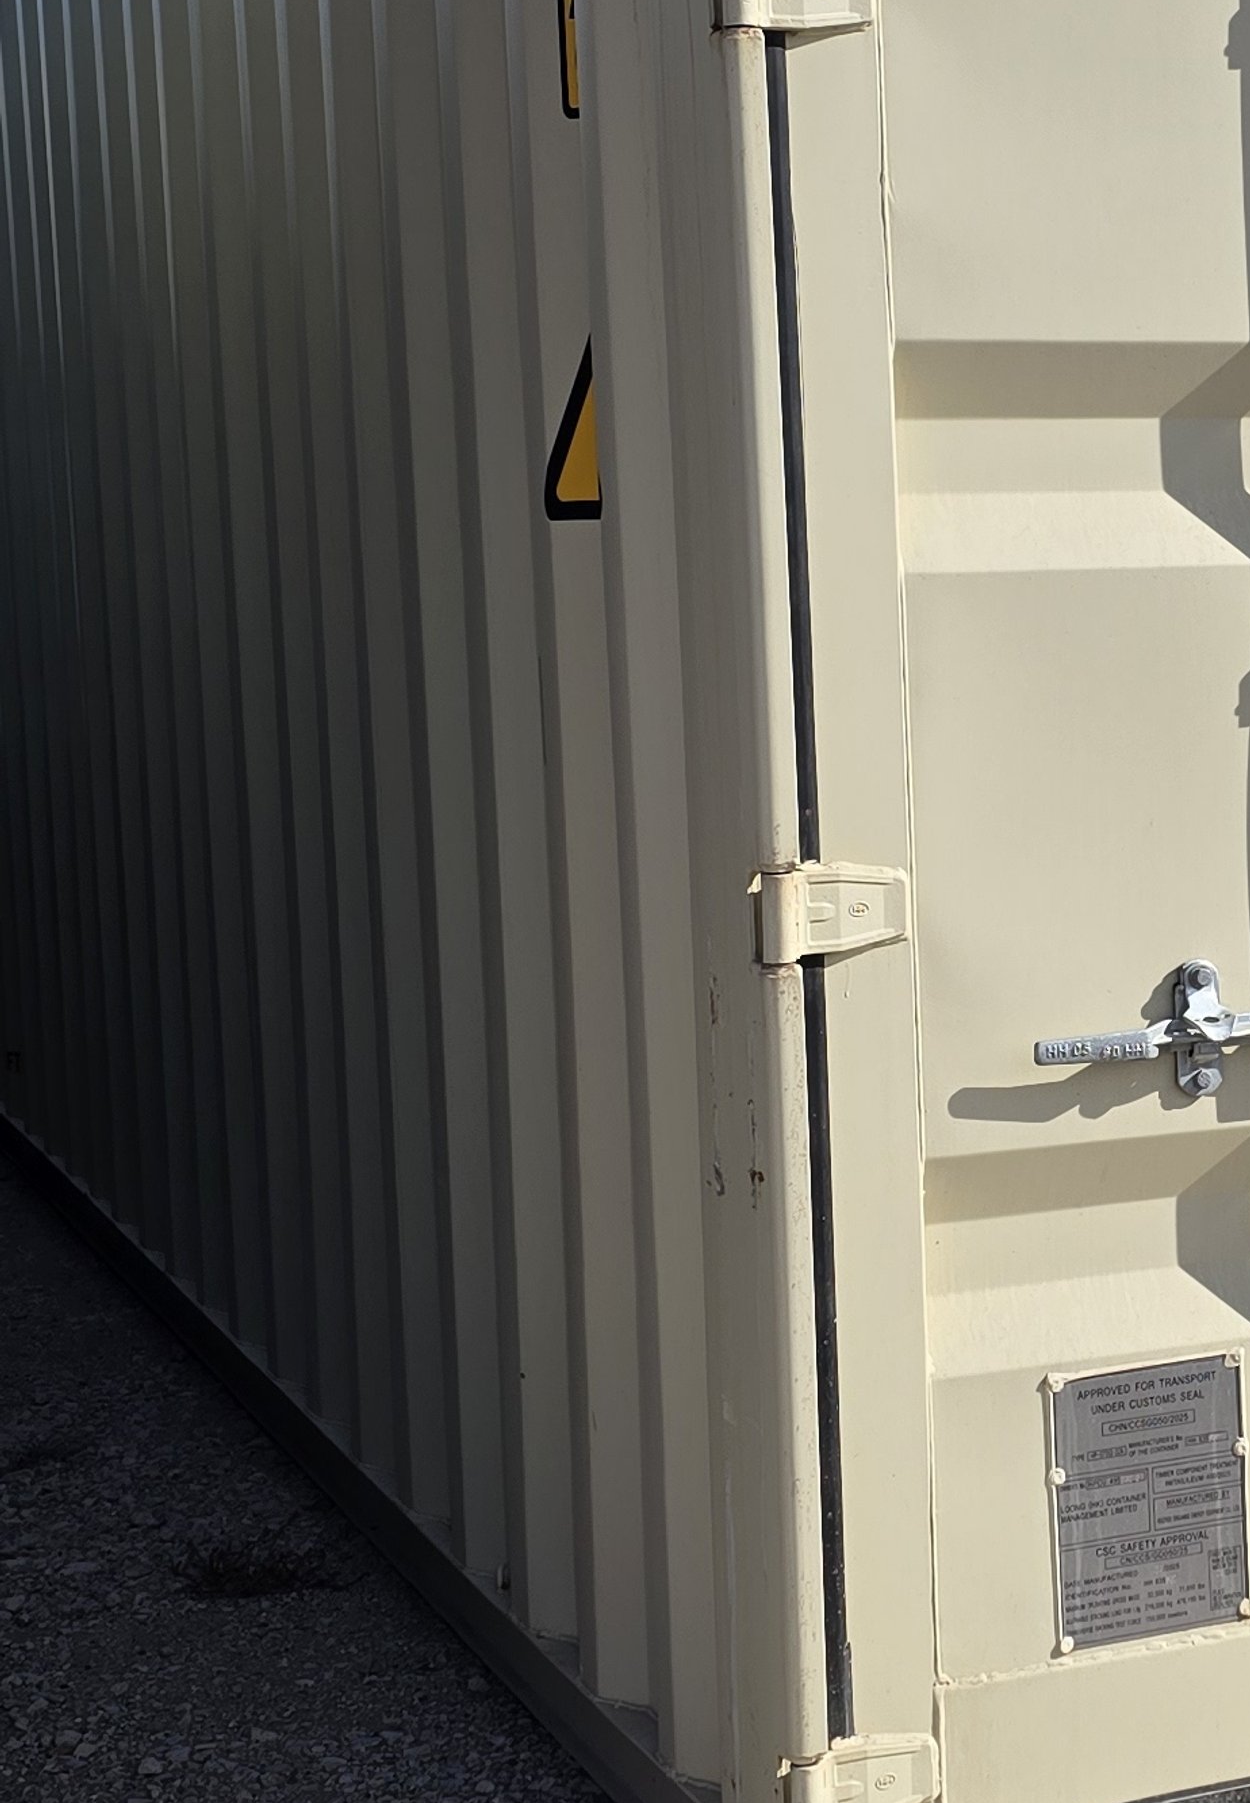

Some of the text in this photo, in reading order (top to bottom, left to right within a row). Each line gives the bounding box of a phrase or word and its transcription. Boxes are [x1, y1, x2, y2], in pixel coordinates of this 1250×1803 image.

[1077, 1371, 1216, 1400] APPROVED FOR TRANSPORT
[1091, 1389, 1205, 1415] UNDER CUSTOMS SEAL
[1095, 1530, 1209, 1558] CSC SAFETY APPROVAL
